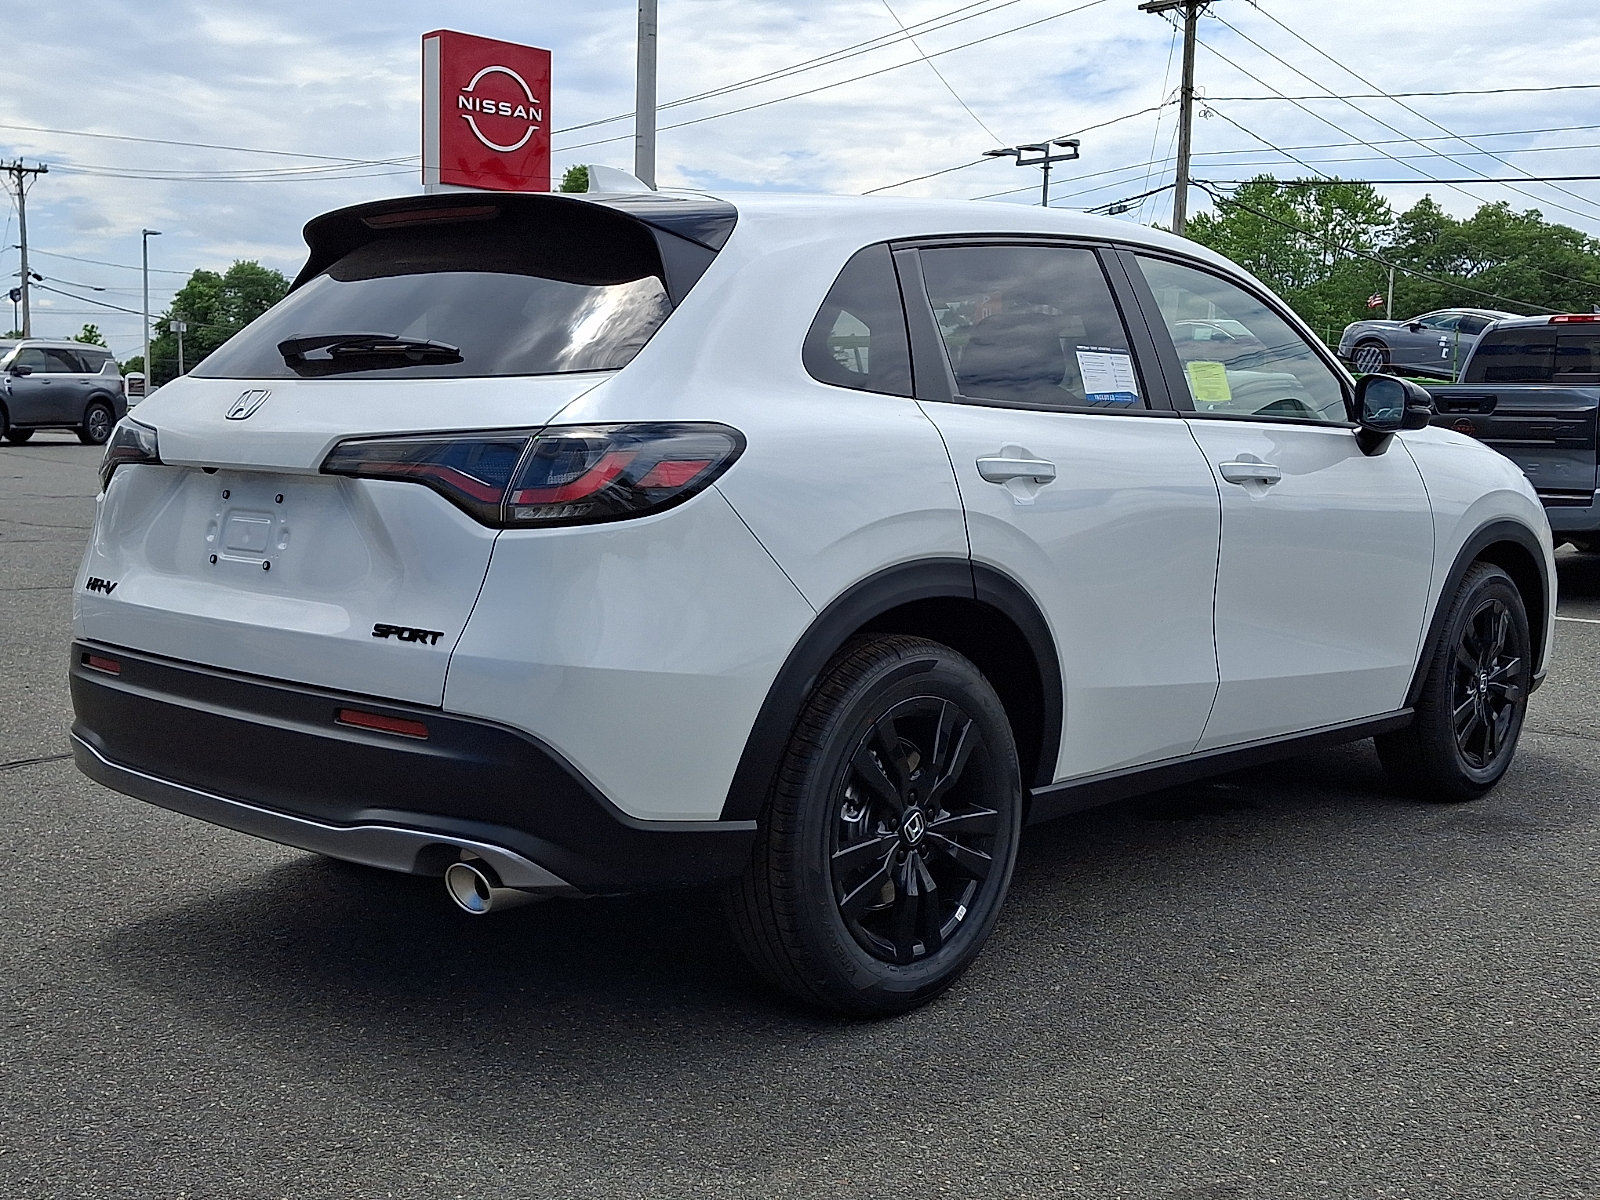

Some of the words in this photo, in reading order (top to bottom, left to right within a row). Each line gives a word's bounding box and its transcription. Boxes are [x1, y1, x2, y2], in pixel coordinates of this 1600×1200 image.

[458, 95, 543, 122] NISSAN
[85, 576, 119, 595] HR-V
[371, 623, 445, 646] SPORT
